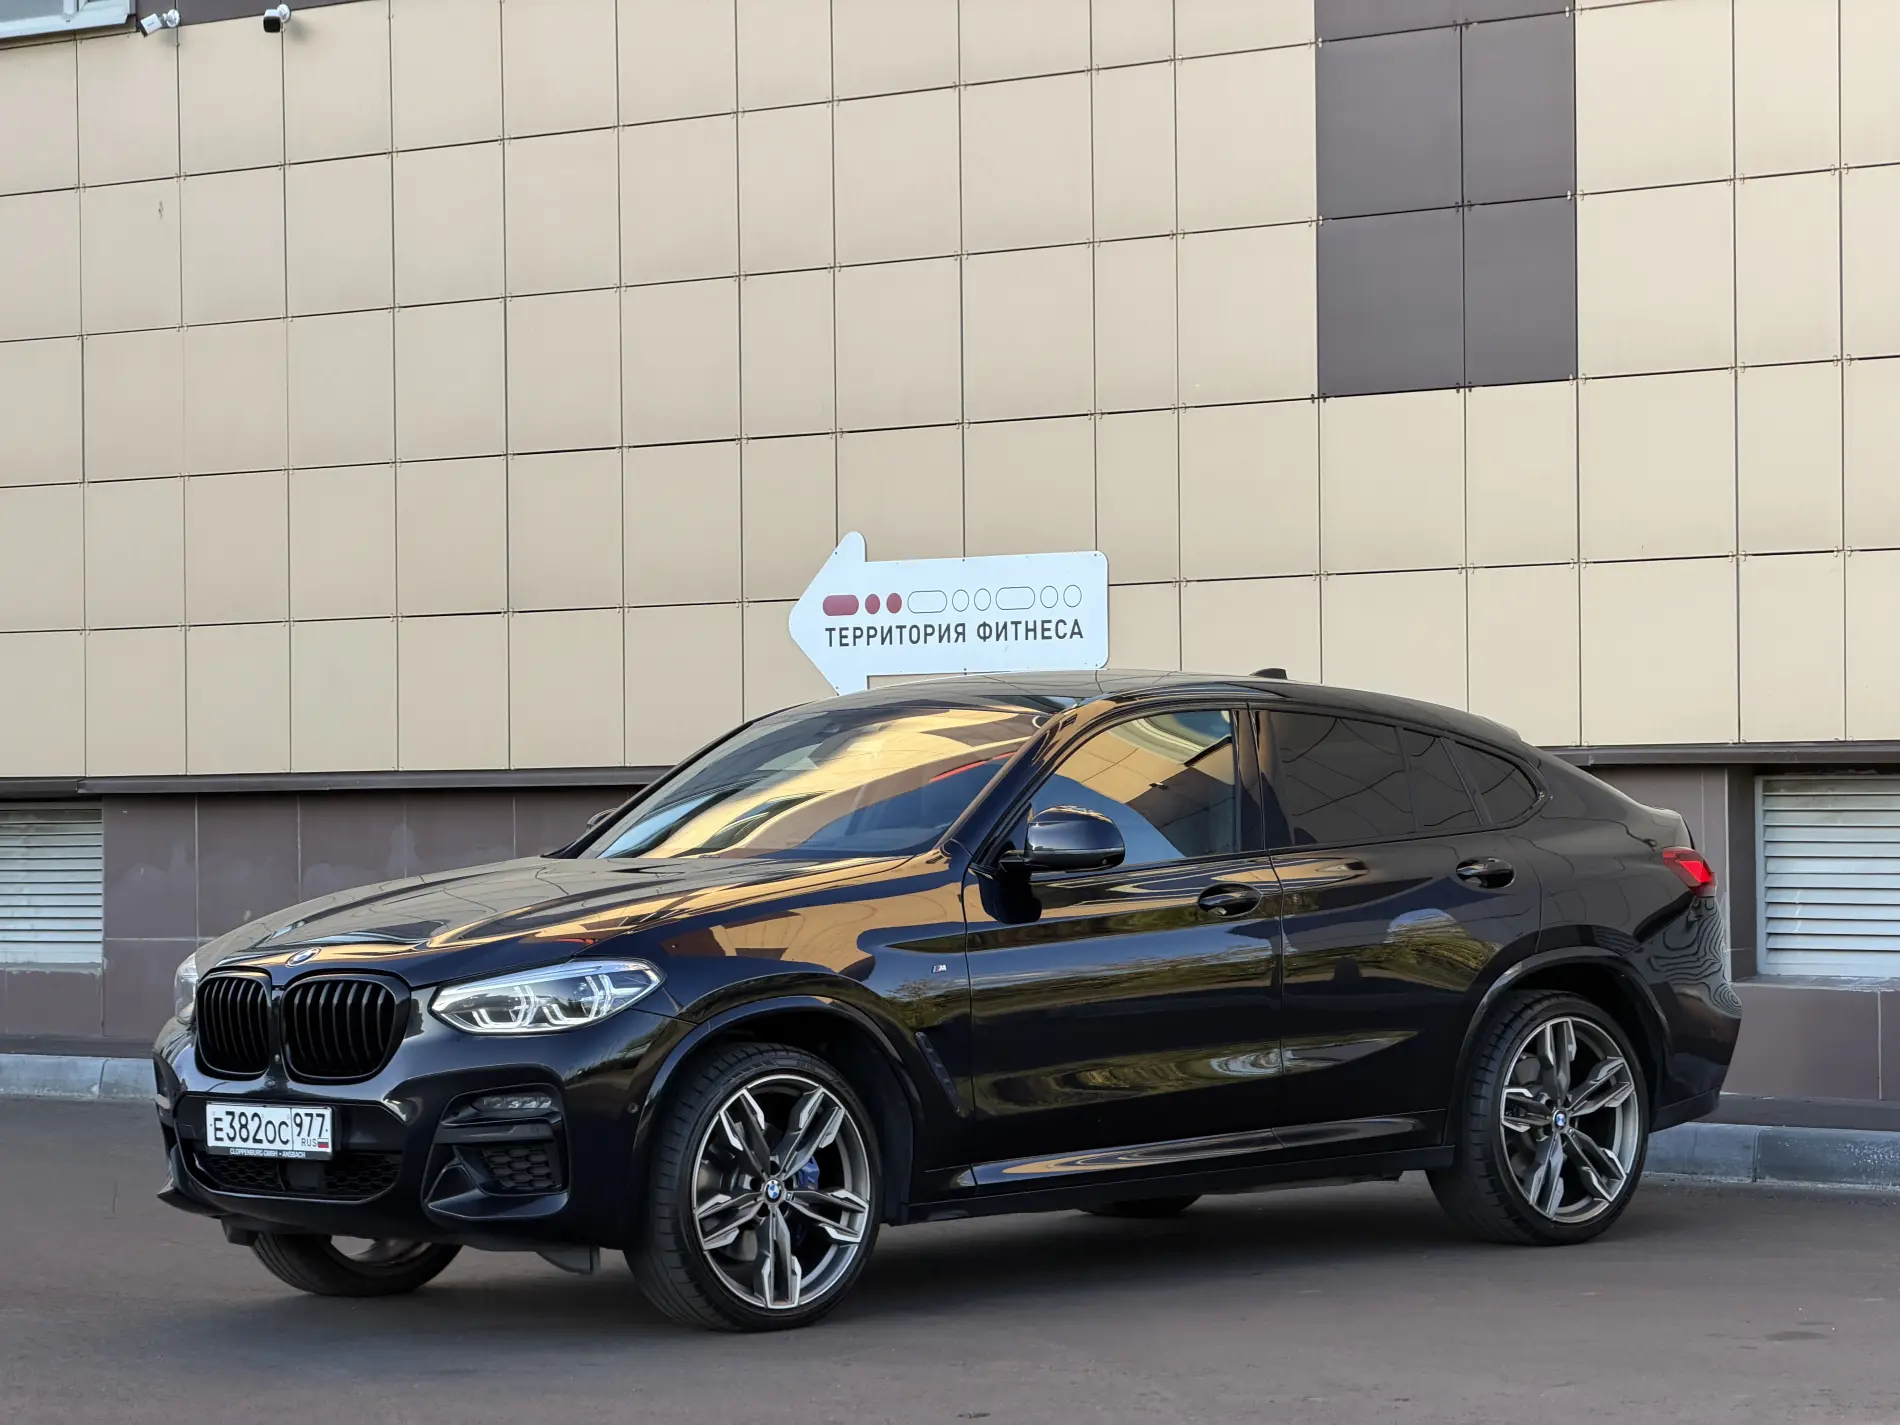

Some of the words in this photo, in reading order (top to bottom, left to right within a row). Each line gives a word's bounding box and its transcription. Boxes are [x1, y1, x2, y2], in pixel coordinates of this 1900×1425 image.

[825, 622, 967, 648] ТЕРРИТОРИЯ
[976, 618, 1084, 642] ФИТНЕСА
[293, 1112, 326, 1138] 977
[301, 1137, 317, 1148] RUS
